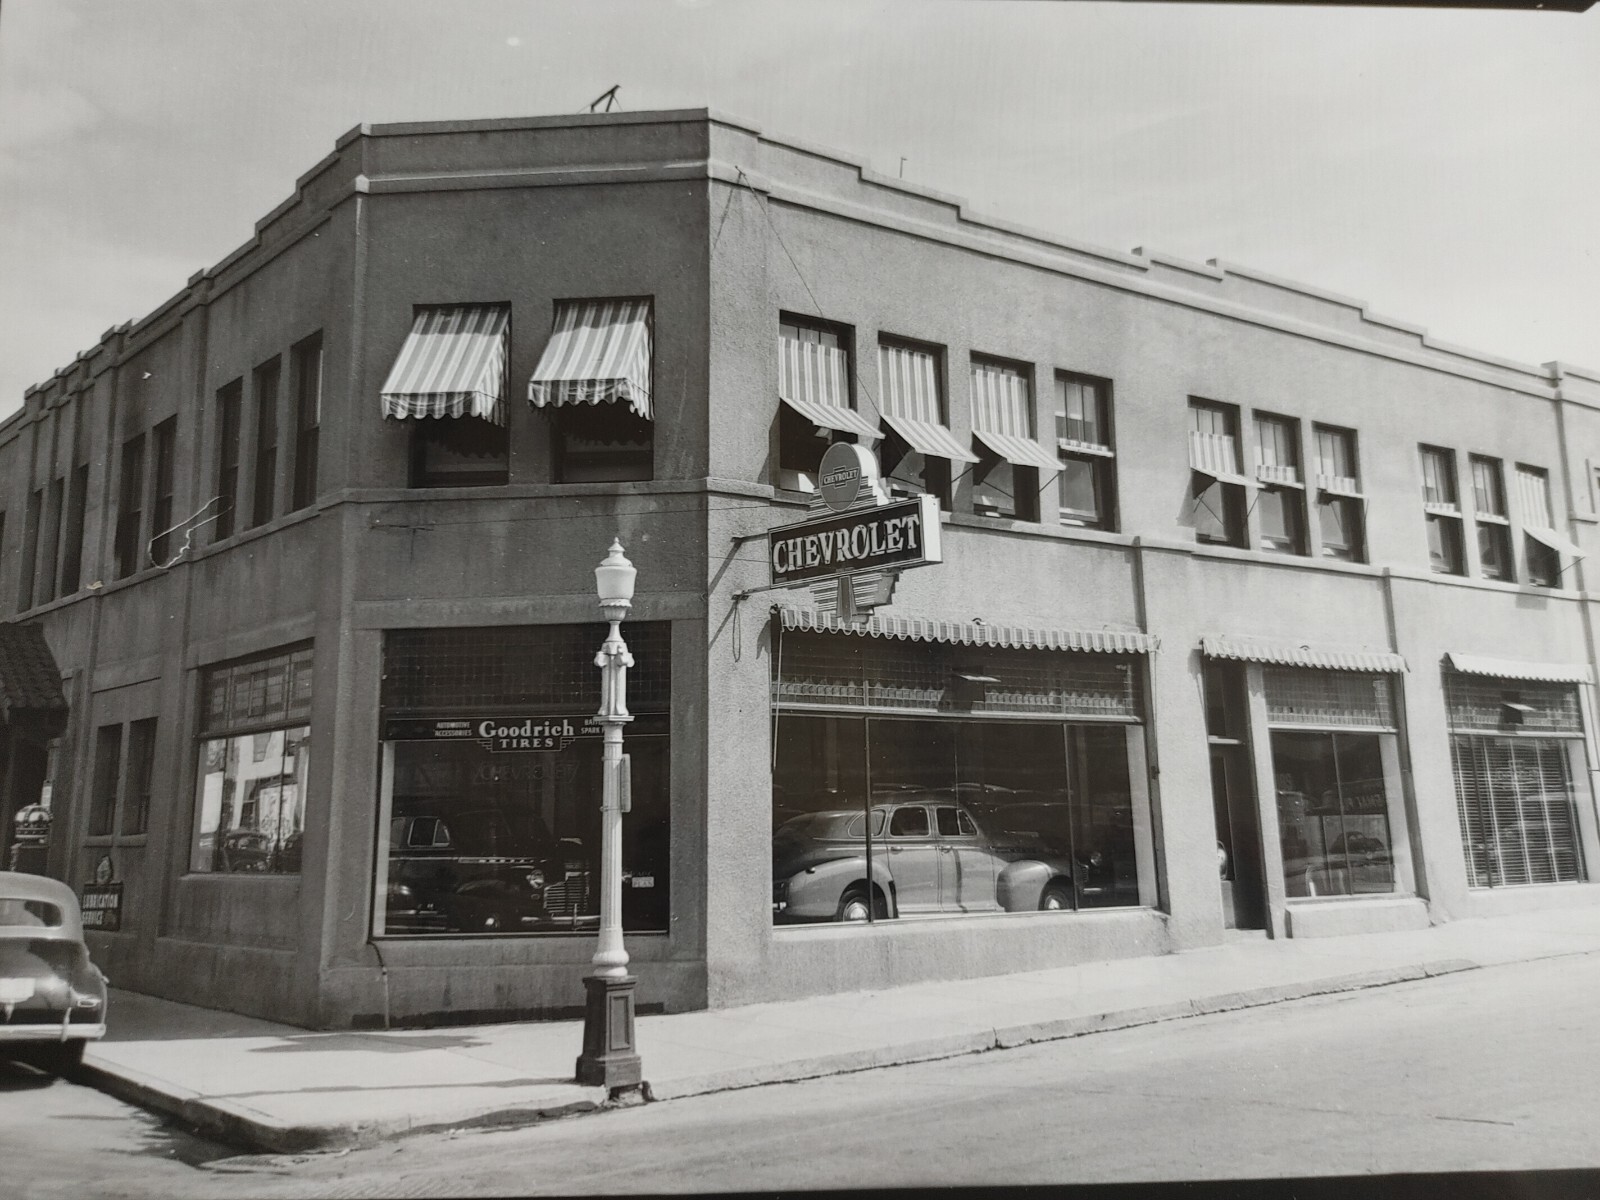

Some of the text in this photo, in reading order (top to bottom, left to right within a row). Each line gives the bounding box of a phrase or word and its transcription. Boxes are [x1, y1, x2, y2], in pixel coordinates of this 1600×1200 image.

[823, 469, 859, 484] CHEVROLET
[773, 513, 920, 574] CHEVROLET
[434, 729, 472, 737] ACCESSORIES
[478, 719, 575, 738] Goodrich
[580, 727, 600, 735] SPARK
[499, 738, 554, 748] TIRES
